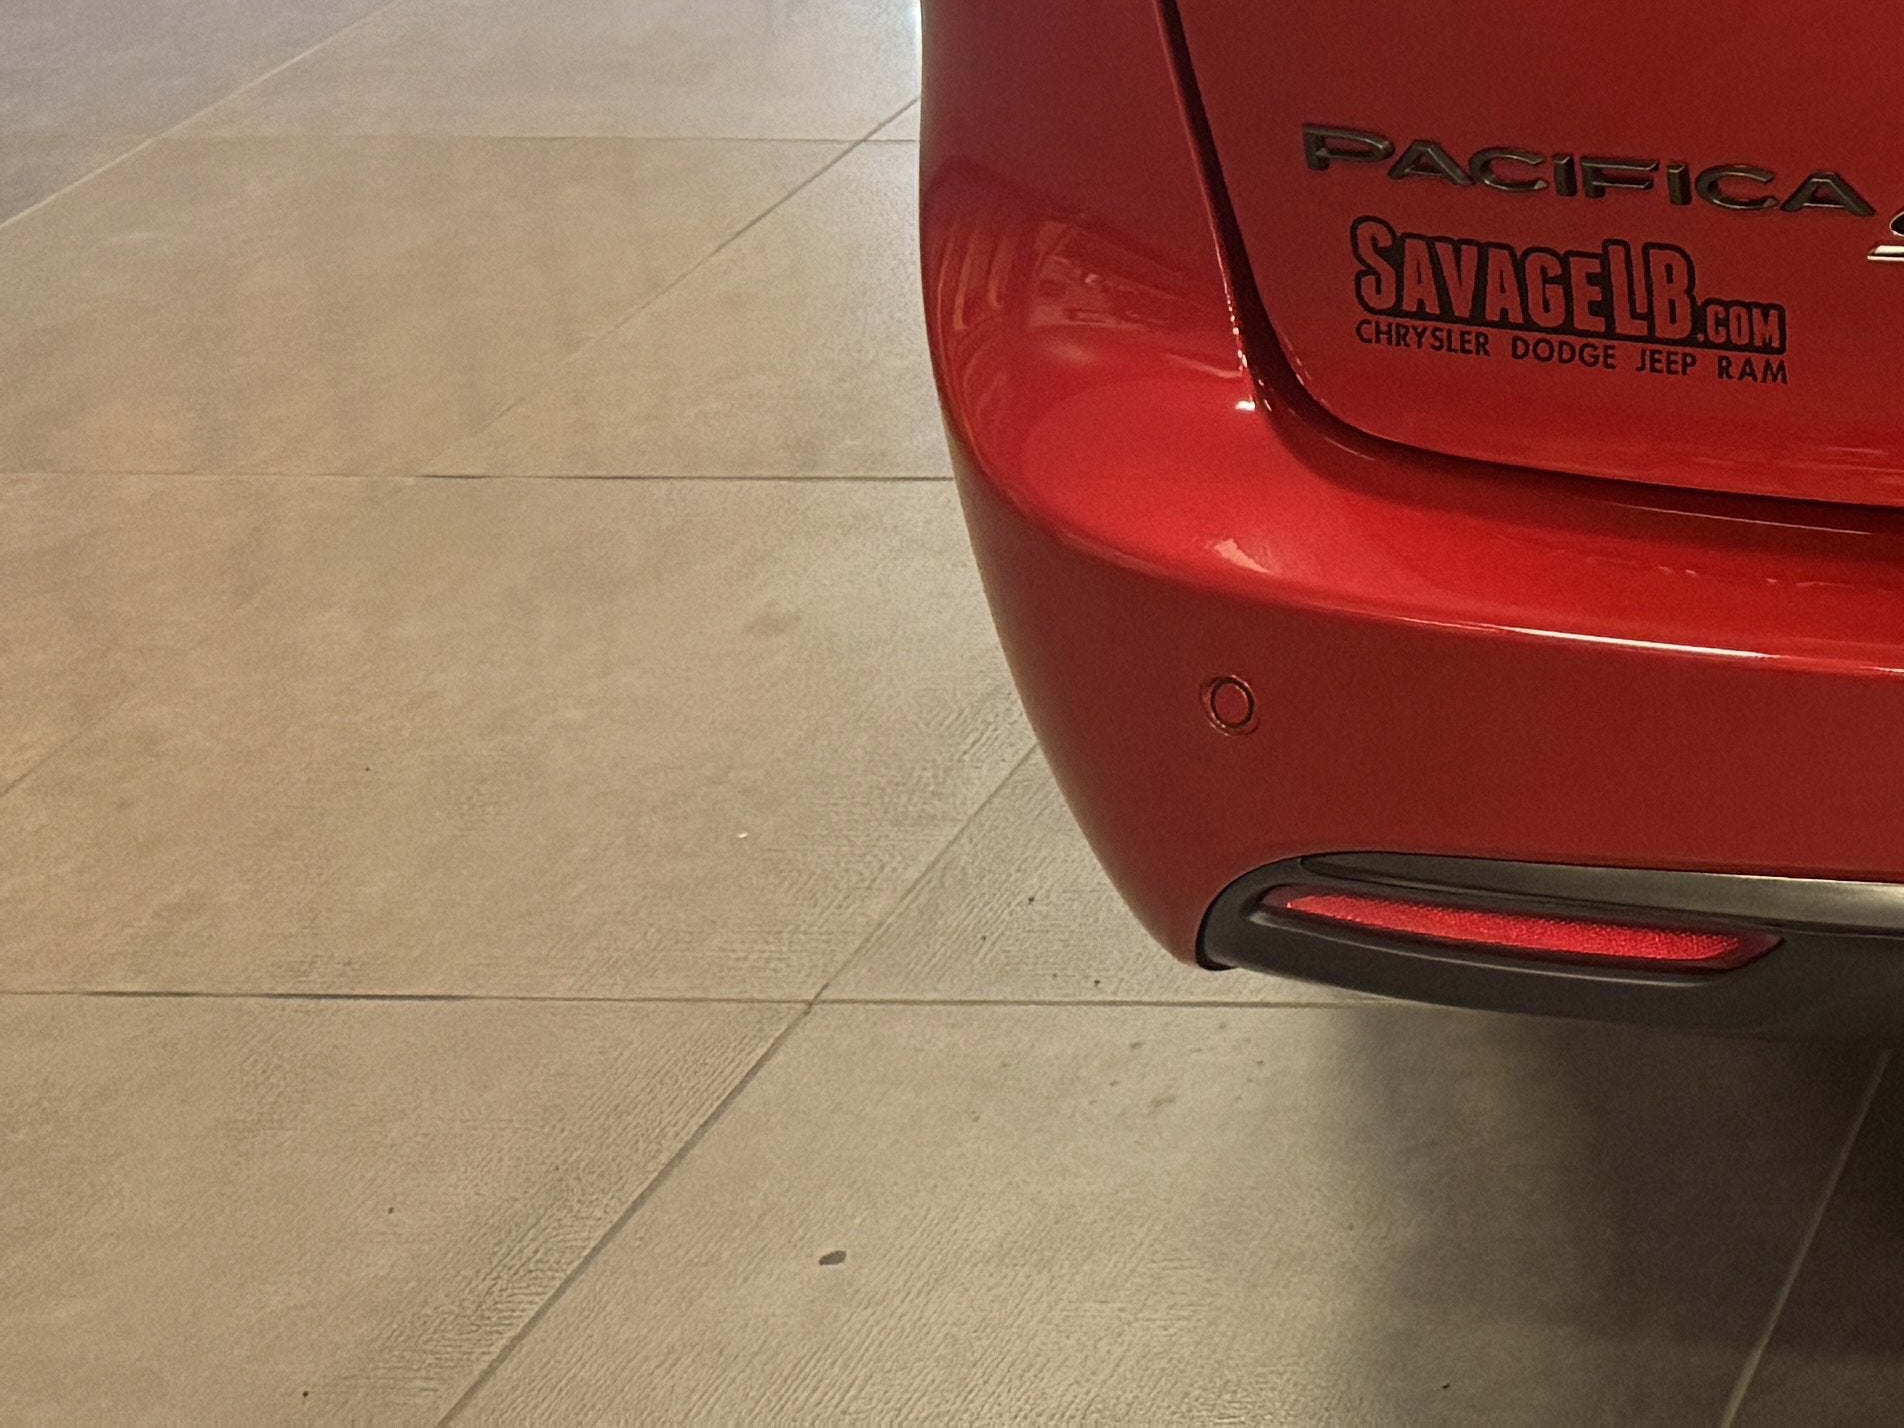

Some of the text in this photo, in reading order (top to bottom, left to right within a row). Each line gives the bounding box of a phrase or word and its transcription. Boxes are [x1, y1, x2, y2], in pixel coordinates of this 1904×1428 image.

[1302, 122, 1877, 217] PACIFICA
[1355, 318, 1788, 385] CHRYSLER DODGE JEEP RAM
